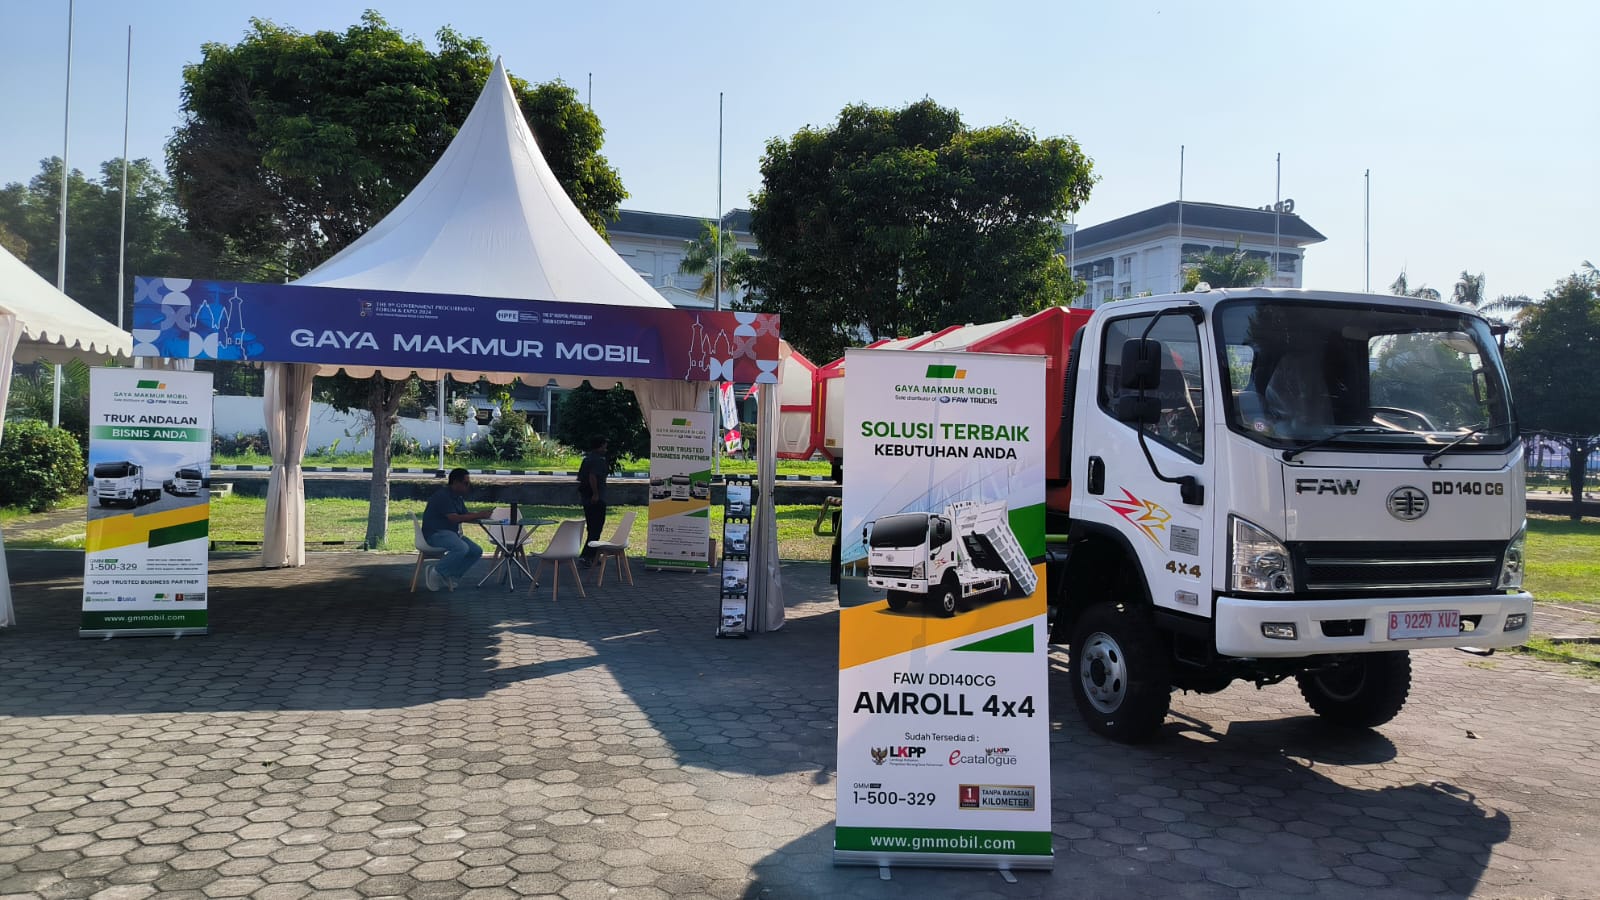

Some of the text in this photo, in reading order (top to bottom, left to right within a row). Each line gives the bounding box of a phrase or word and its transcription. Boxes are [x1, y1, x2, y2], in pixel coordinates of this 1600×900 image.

[290, 328, 650, 364] GAYA MAKMUR MOBIL
[894, 384, 998, 395] GAYA MAKMUR MOBIL
[104, 414, 198, 425] TRUK ANDALAN
[112, 428, 188, 439] BISNIS ANDA
[861, 420, 1030, 442] SOLUSI TERBAIK
[874, 444, 1017, 460] KEBUTUHAN ANDA
[1295, 478, 1361, 495] FAW
[1484, 483, 1504, 495] CG
[1166, 560, 1201, 578] 4x4
[104, 614, 185, 623] www.gmmobil.com
[1390, 612, 1458, 629] B 9229 XVZ
[894, 672, 996, 686] FAW DD140CG
[853, 692, 1035, 718] AMROLL 4x4
[904, 732, 931, 741] Sudah
[932, 733, 966, 742] Tersedia
[967, 734, 975, 742] di
[890, 746, 926, 758] LKPP
[853, 791, 936, 806] 1-500-329
[967, 788, 972, 798] 1
[982, 798, 1029, 806] KILOMETER
[870, 835, 1016, 850] www.gmmobil.com
